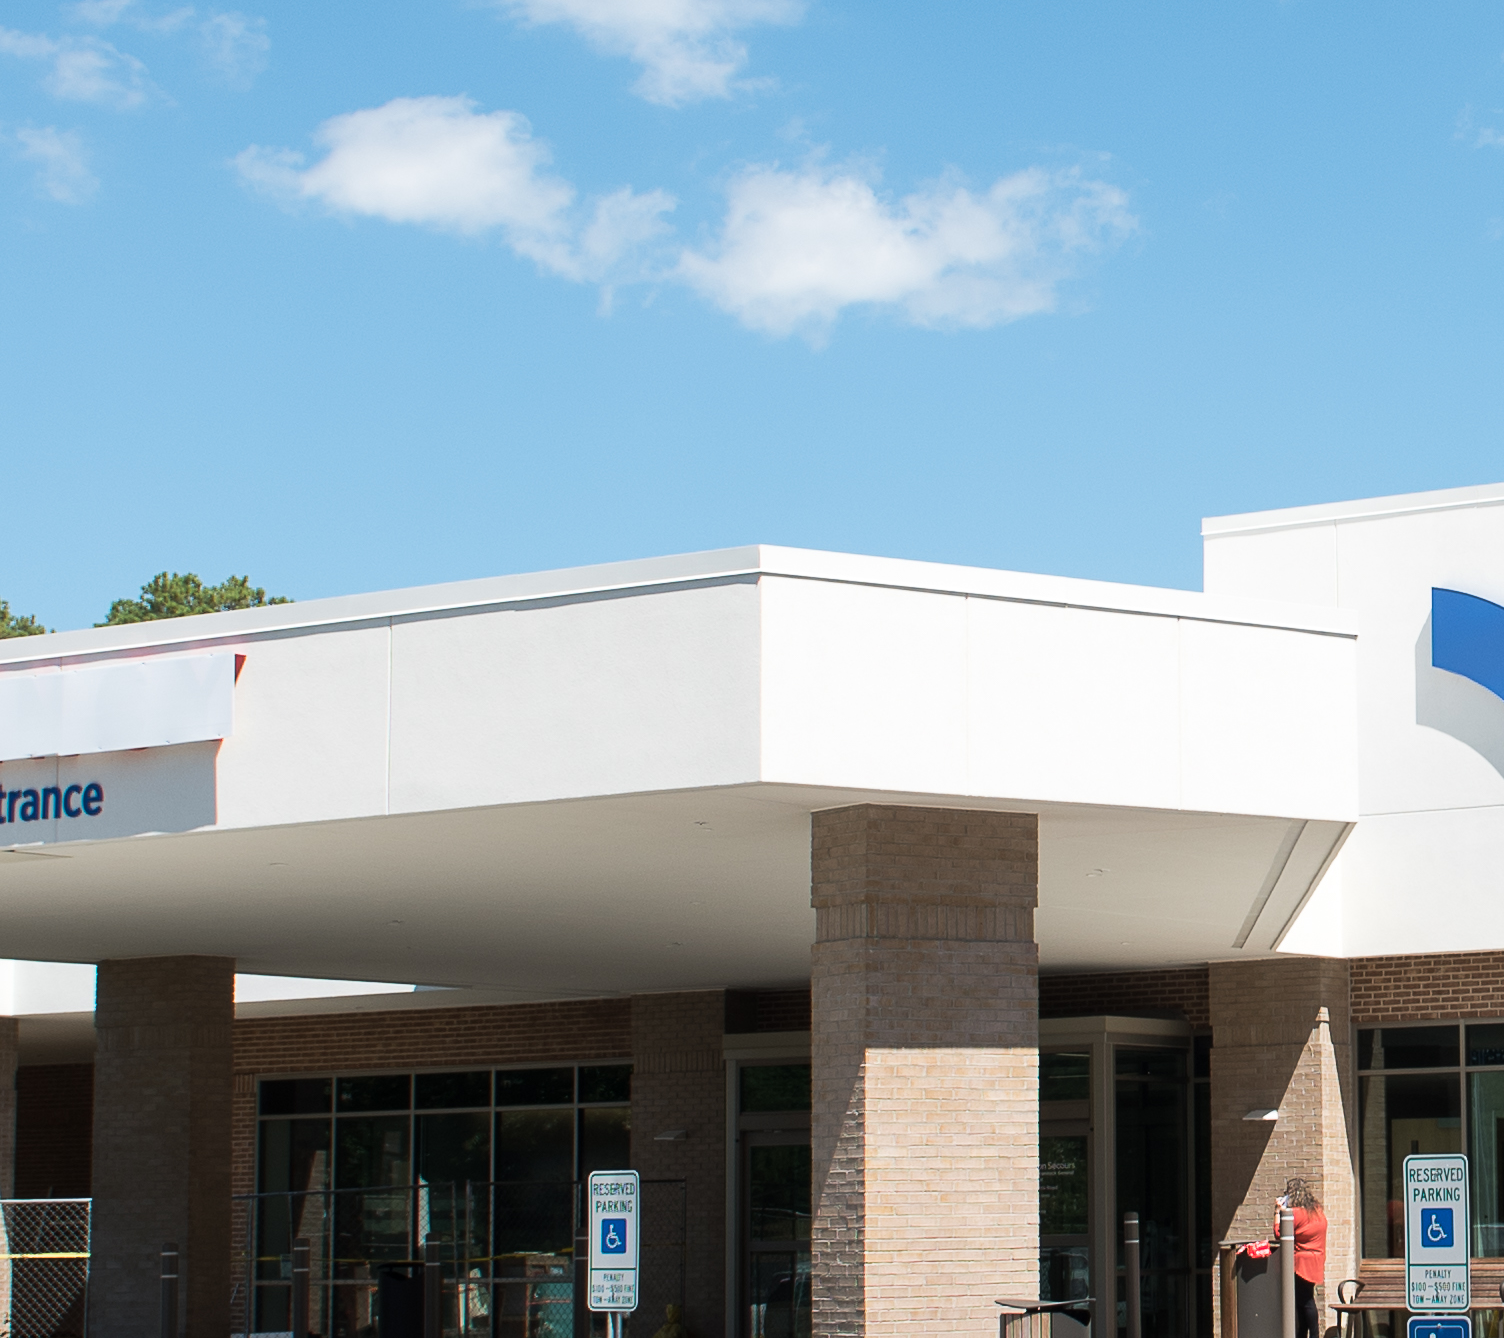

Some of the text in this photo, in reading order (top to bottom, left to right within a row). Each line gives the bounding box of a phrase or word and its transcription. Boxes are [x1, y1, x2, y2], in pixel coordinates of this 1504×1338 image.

[1409, 1167, 1463, 1182] RESERVED
[593, 1183, 635, 1195] RESERVED
[1413, 1187, 1460, 1202] PARKING
[596, 1200, 633, 1213] PARKING
[1425, 1269, 1451, 1279] PENALTY
[1452, 1281, 1465, 1292] FINE
[1450, 1294, 1464, 1304] ZONE
